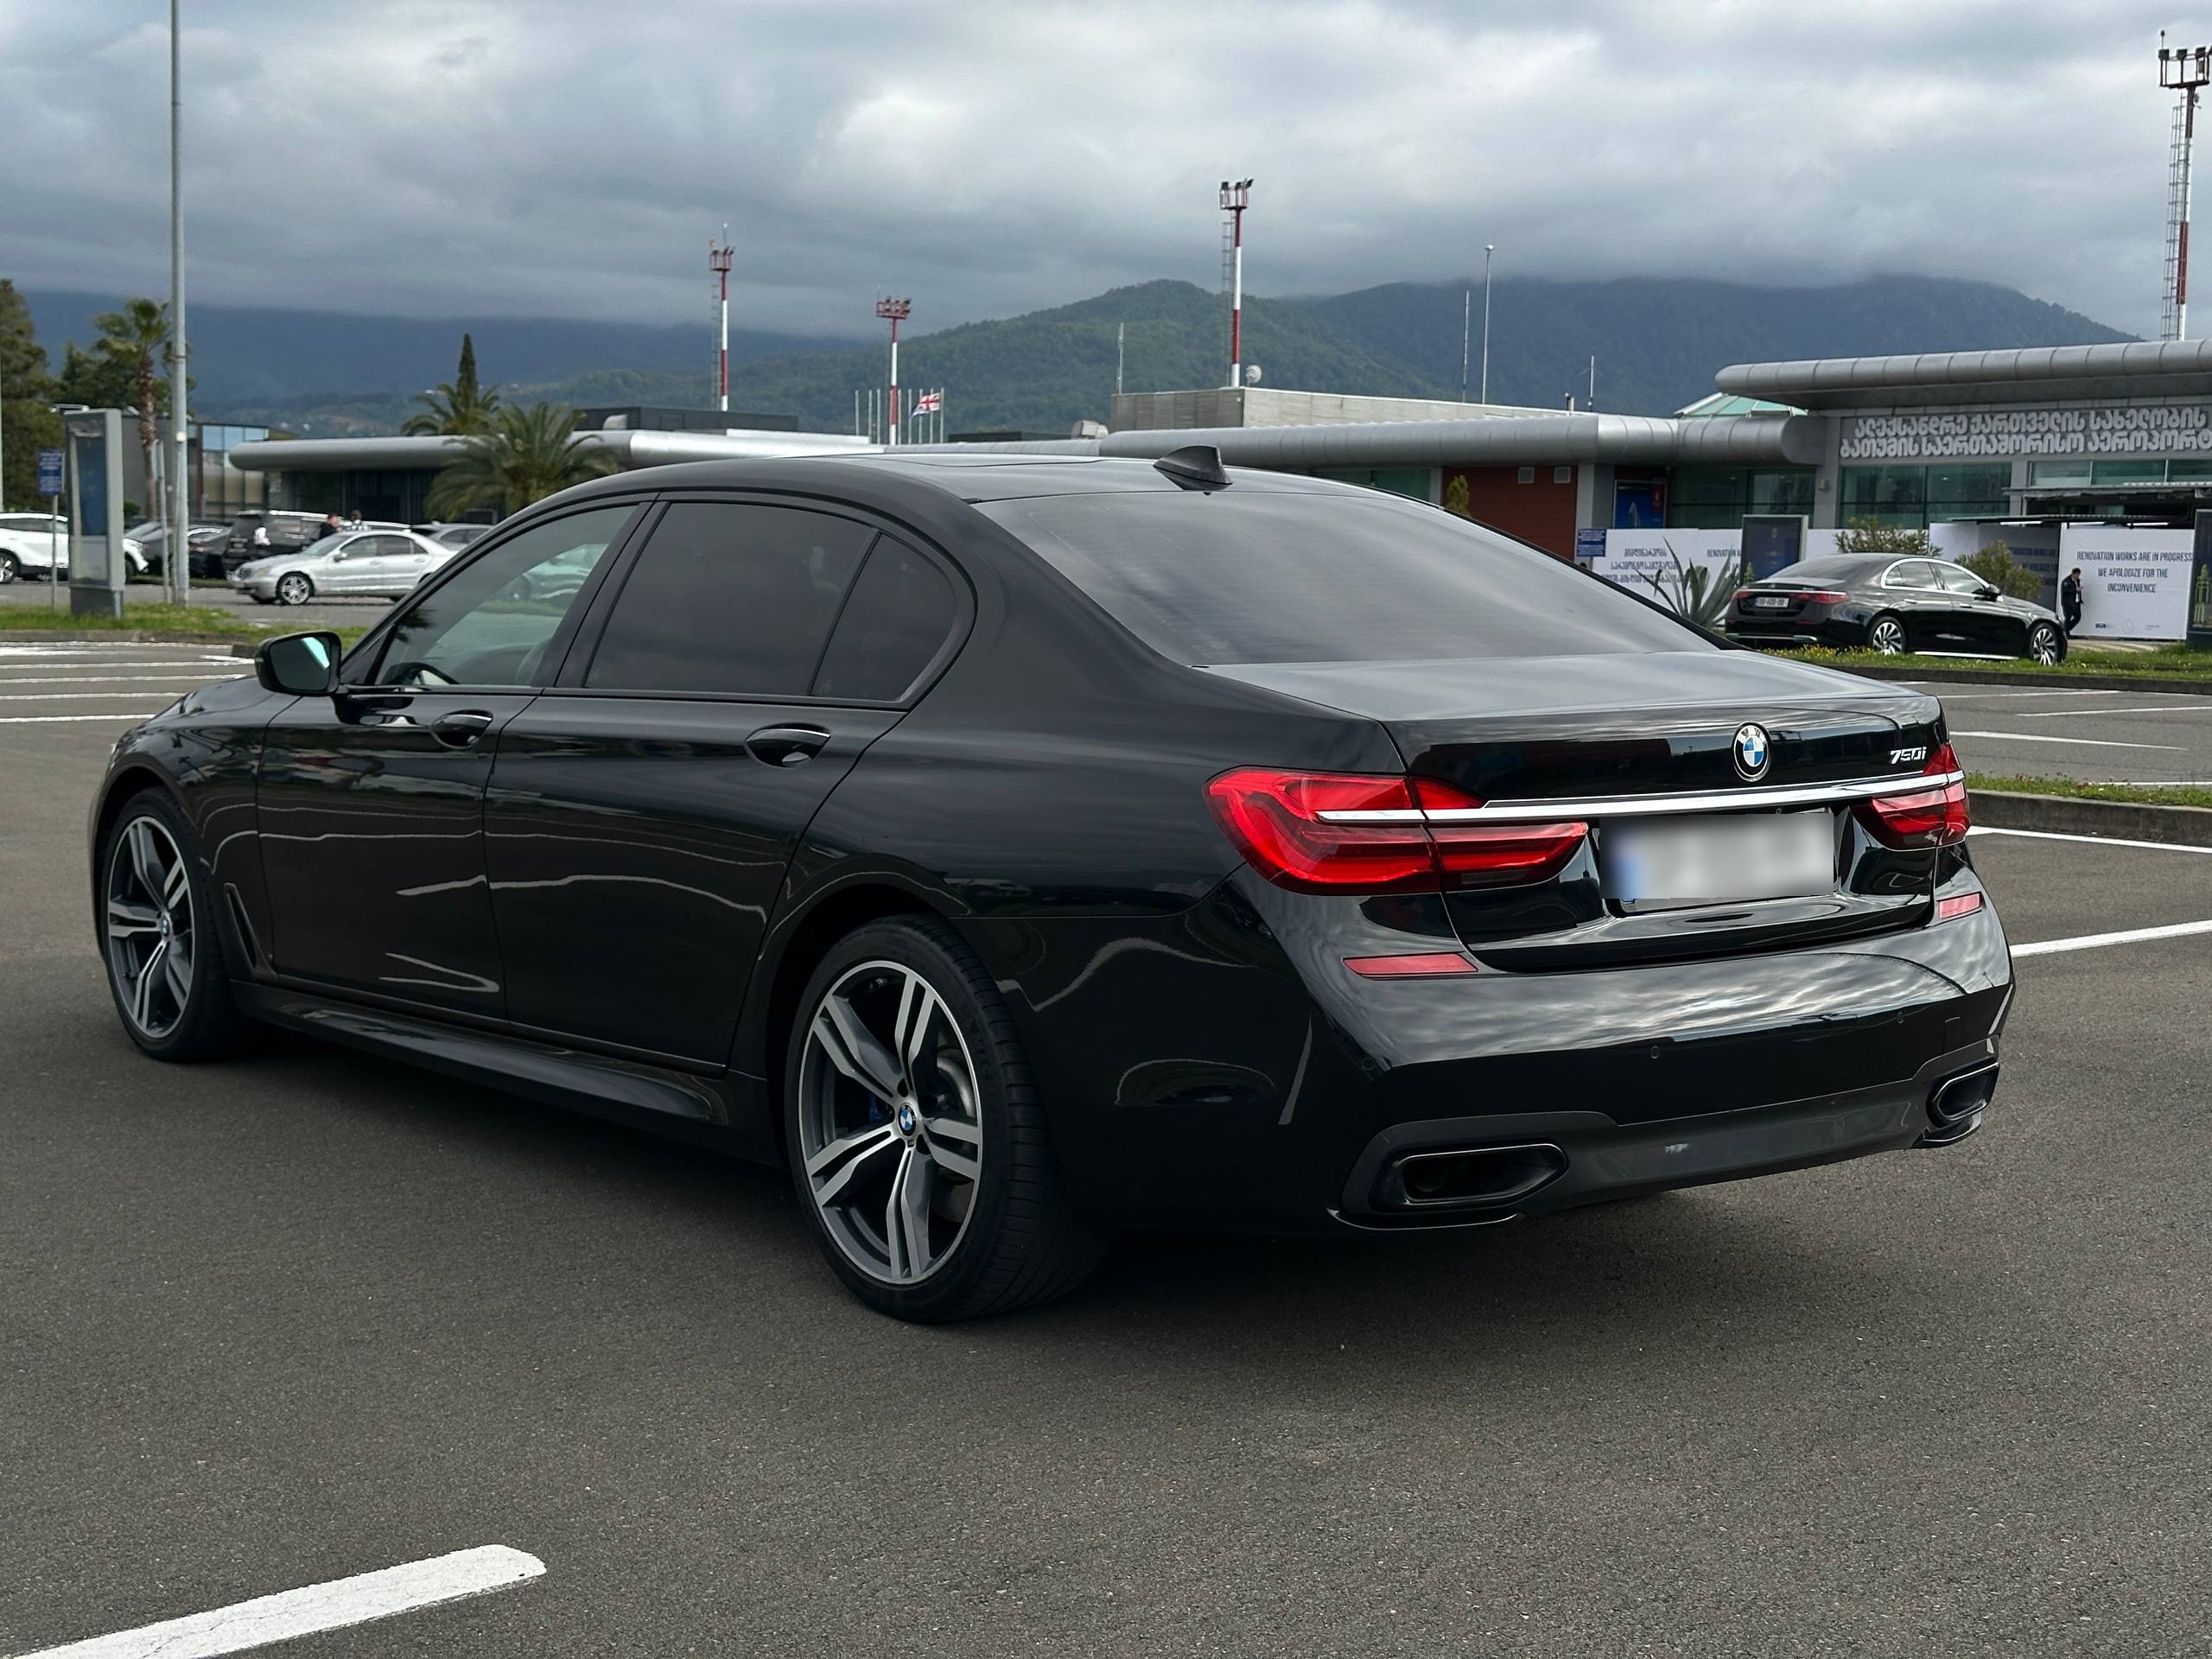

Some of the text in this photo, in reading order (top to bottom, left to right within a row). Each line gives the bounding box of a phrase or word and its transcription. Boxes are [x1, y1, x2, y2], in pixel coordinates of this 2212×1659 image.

[1854, 407, 2207, 438] ალექსანდრე ქართველის სახელობის
[1840, 435, 1919, 458] ბათუმის
[1921, 432, 2084, 457] საერთაშორისო
[2076, 551, 2114, 562] RENOVATION
[2115, 551, 2138, 562] WORKS
[2139, 551, 2152, 562] ARE
[2152, 552, 2158, 562] IN
[2097, 568, 2168, 578] WE APOLOGIZE FOR THE
[2107, 583, 2157, 594] INCONVENIENCE
[1890, 746, 1927, 764] 750i
